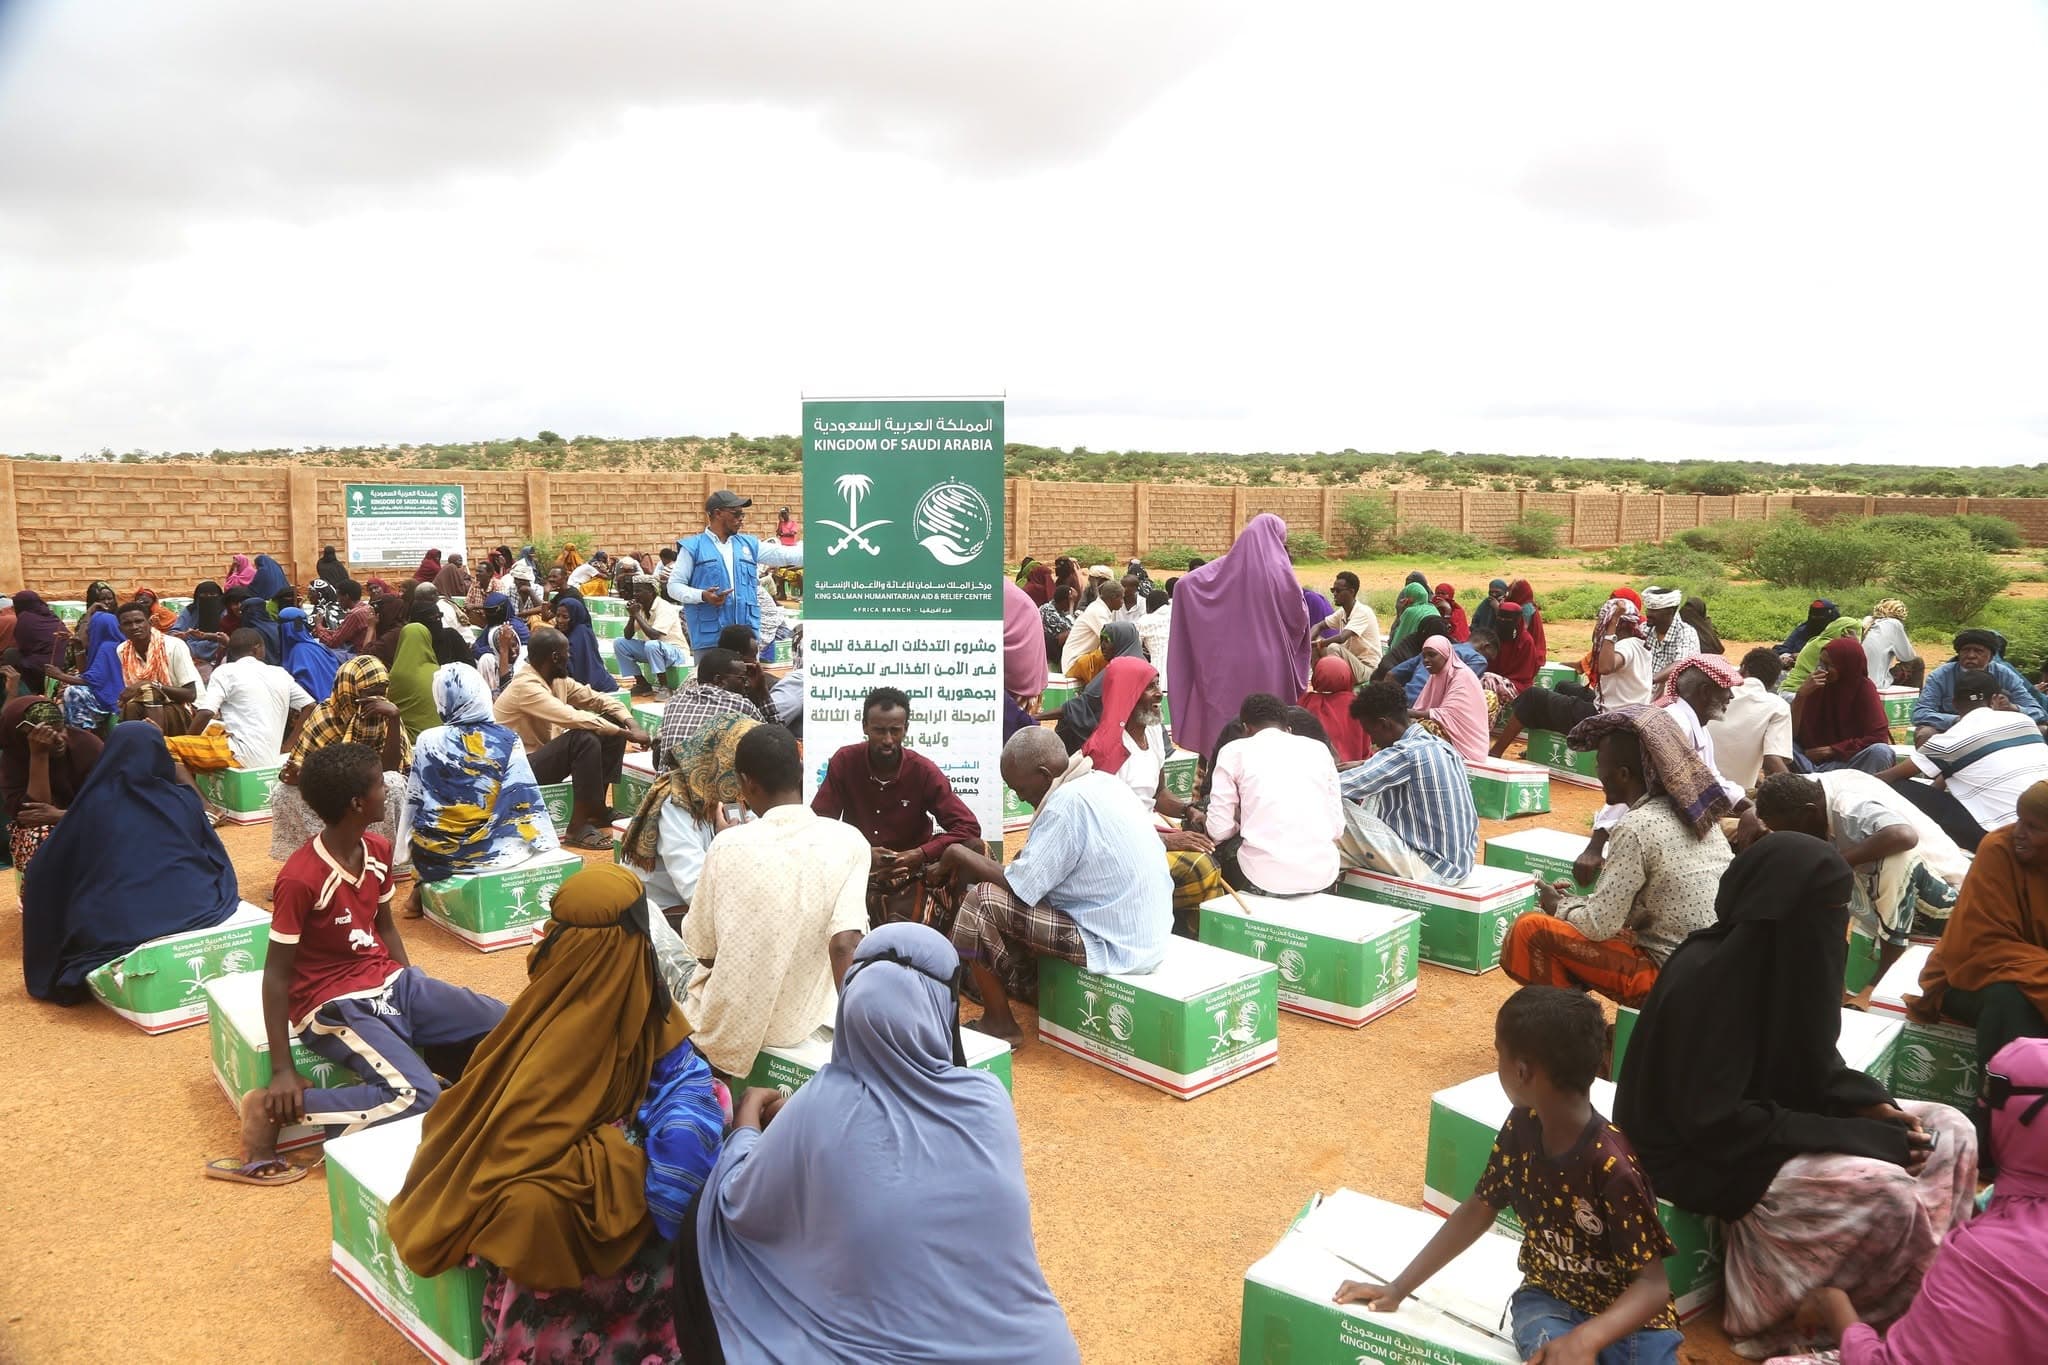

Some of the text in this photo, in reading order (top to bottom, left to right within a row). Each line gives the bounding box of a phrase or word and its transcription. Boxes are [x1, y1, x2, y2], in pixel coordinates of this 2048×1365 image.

[813, 417, 993, 435] المملكة العربية السعودية
[814, 438, 993, 450] KINGDOM OF SAUDI ARABIA
[814, 592, 832, 600] KING
[832, 592, 863, 600] SALMAN
[864, 592, 920, 600] HUMANITARIAN
[920, 592, 934, 600] AID
[934, 592, 940, 600] &
[940, 592, 964, 600] RELIEF
[810, 638, 997, 654] مشروع التدخلات المنقذة للحياة
[810, 662, 876, 678] للمتضررين
[934, 660, 969, 677] الأمن
[972, 663, 997, 677] في
[937, 685, 997, 702] بجمهورية
[810, 708, 850, 722] الثالثة
[951, 709, 996, 725] المرحلة
[918, 731, 949, 748] ولاية
[1543, 1229, 1574, 1254] Fly
[1341, 1319, 1392, 1346] السعودية
[1339, 1333, 1388, 1358] KINGDOM
[1389, 1351, 1403, 1363] OF
[1393, 1336, 1432, 1359] العربية
